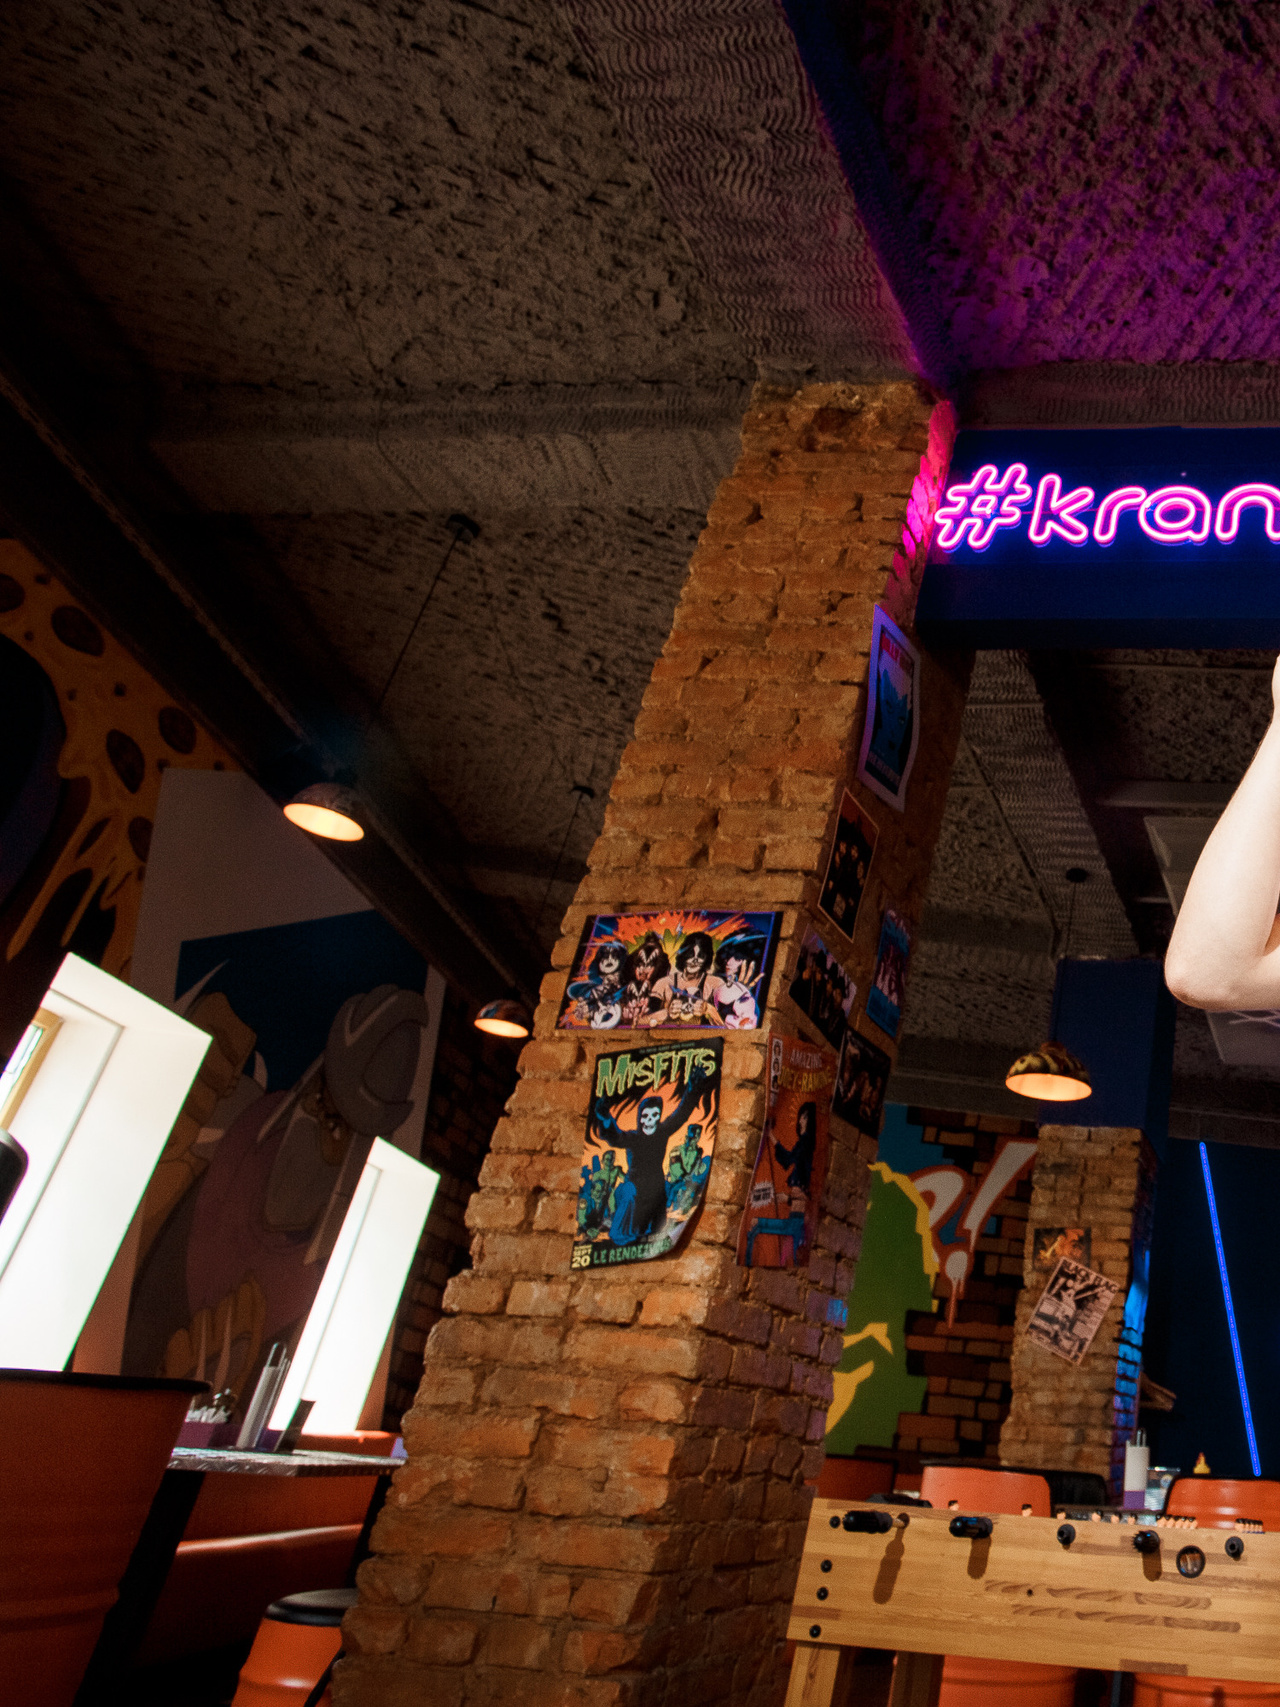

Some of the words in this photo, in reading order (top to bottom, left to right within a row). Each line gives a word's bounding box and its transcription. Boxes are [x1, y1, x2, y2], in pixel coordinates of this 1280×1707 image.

[595, 1048, 717, 1097] MISFITS
[571, 1255, 591, 1269] 20
[593, 1249, 607, 1265] LE
